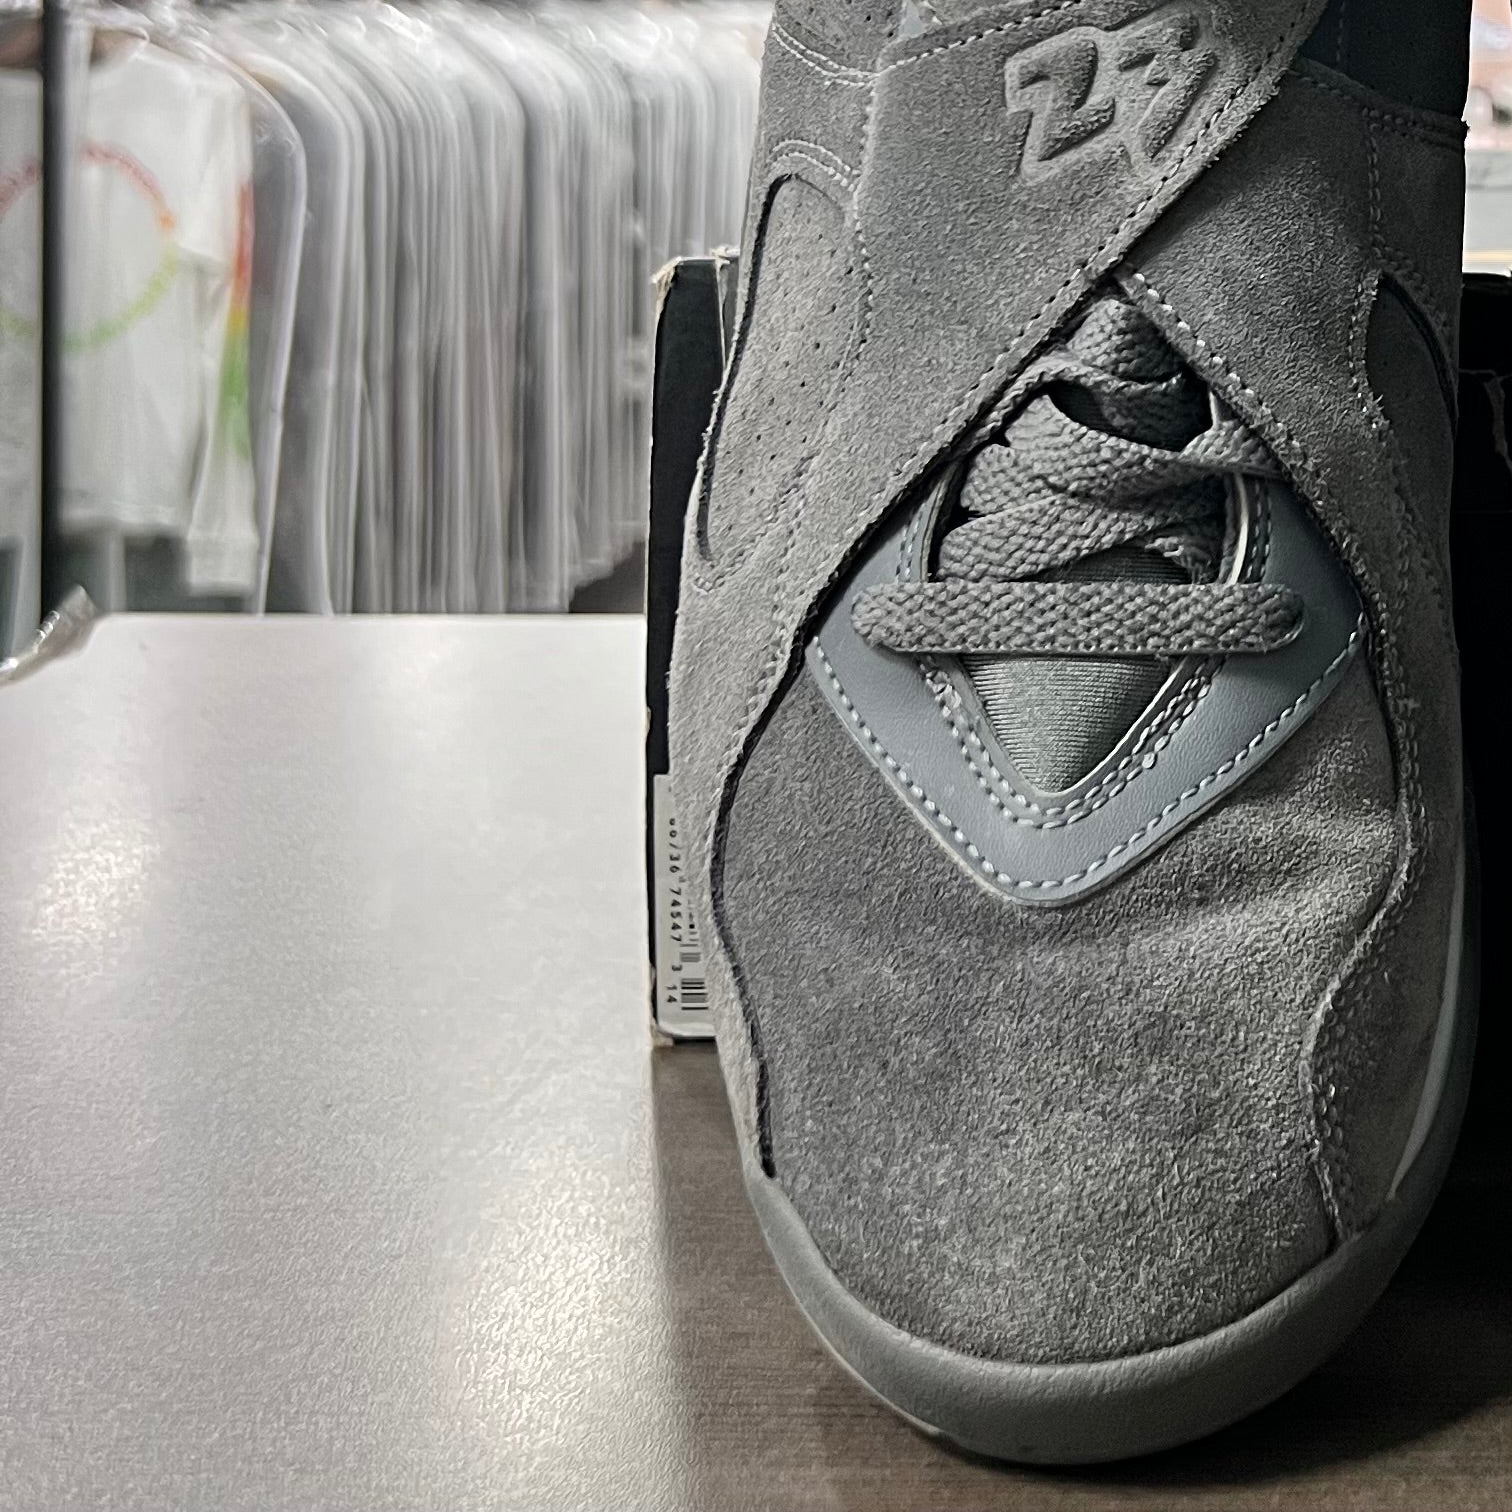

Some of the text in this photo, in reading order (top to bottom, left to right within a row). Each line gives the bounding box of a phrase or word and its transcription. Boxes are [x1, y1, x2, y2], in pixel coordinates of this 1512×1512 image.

[1007, 11, 1217, 178] 23
[670, 887, 683, 942] 74547
[672, 964, 684, 972] 3
[666, 985, 678, 1003] 14
